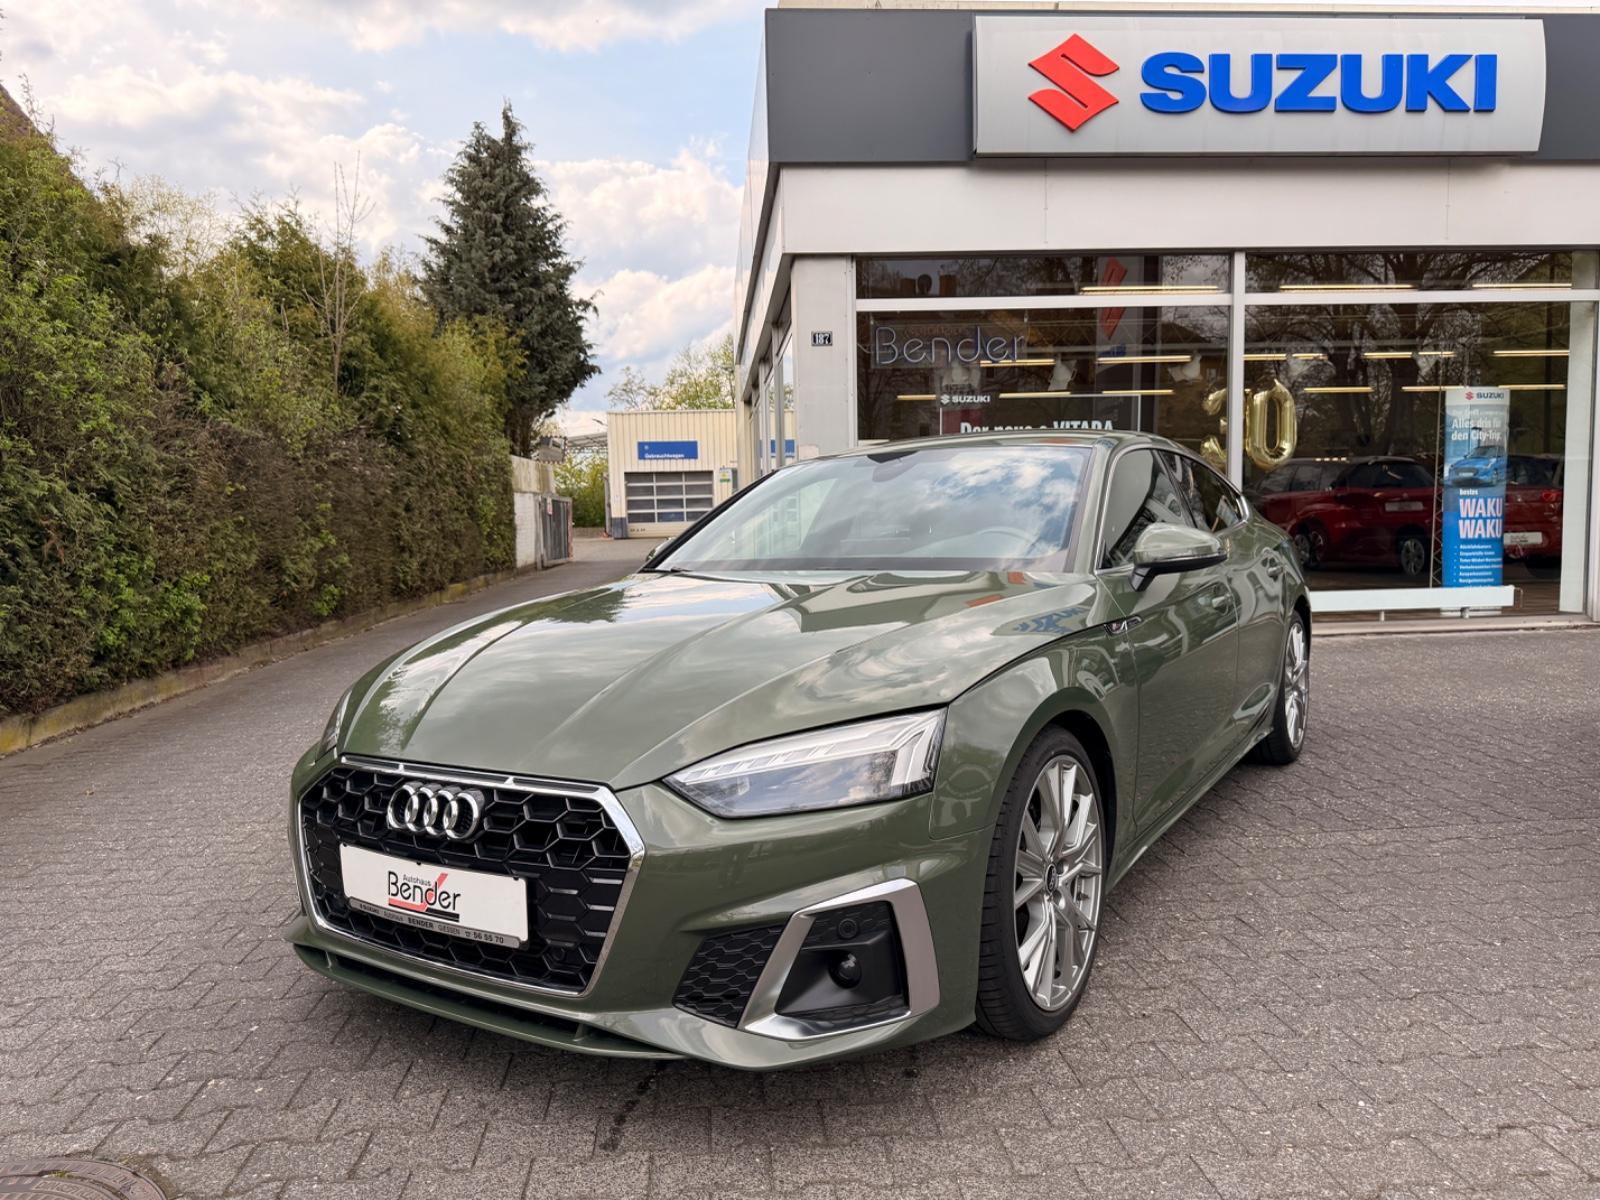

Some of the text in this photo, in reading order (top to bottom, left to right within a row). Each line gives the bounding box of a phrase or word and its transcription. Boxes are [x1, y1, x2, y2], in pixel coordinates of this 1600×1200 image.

[1140, 51, 1498, 112] SUZUKI
[813, 332, 831, 345] 187
[874, 326, 1025, 364] Bender
[951, 395, 991, 403] SUZUKI
[1451, 430, 1469, 440] den
[1459, 497, 1503, 518] WAKU
[1458, 519, 1502, 539] WAKU
[403, 874, 432, 887] Autohaus
[388, 871, 461, 910] Bender
[407, 916, 434, 929] BENDER
